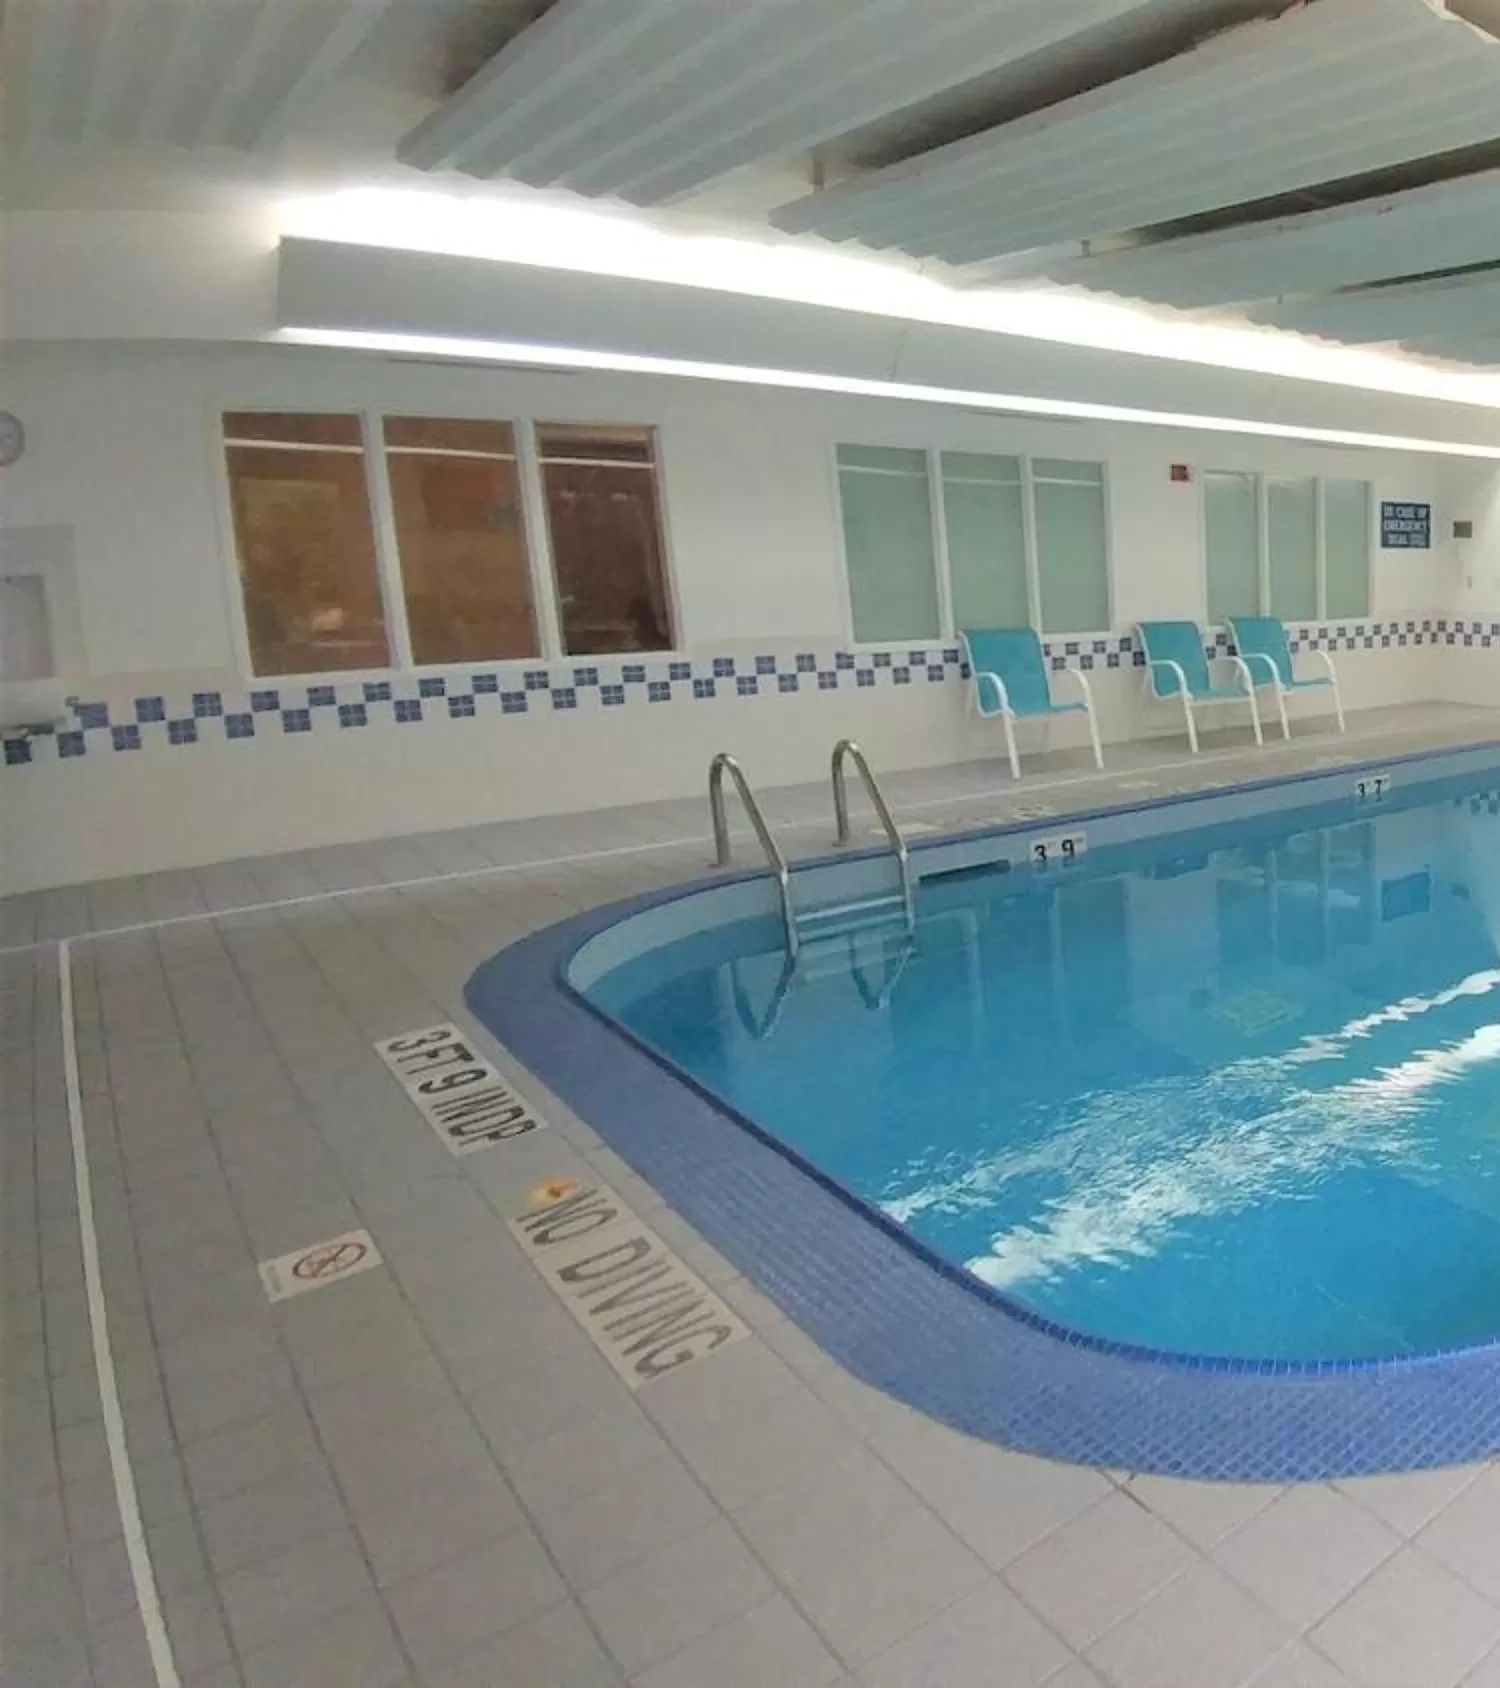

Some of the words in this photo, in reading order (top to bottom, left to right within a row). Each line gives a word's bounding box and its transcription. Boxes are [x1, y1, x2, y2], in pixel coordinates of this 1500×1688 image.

[1035, 844, 1047, 862] 3
[1062, 839, 1075, 858] 9
[417, 1068, 488, 1095] 9
[515, 1188, 618, 1246] NO
[556, 1237, 733, 1378] DIVING
